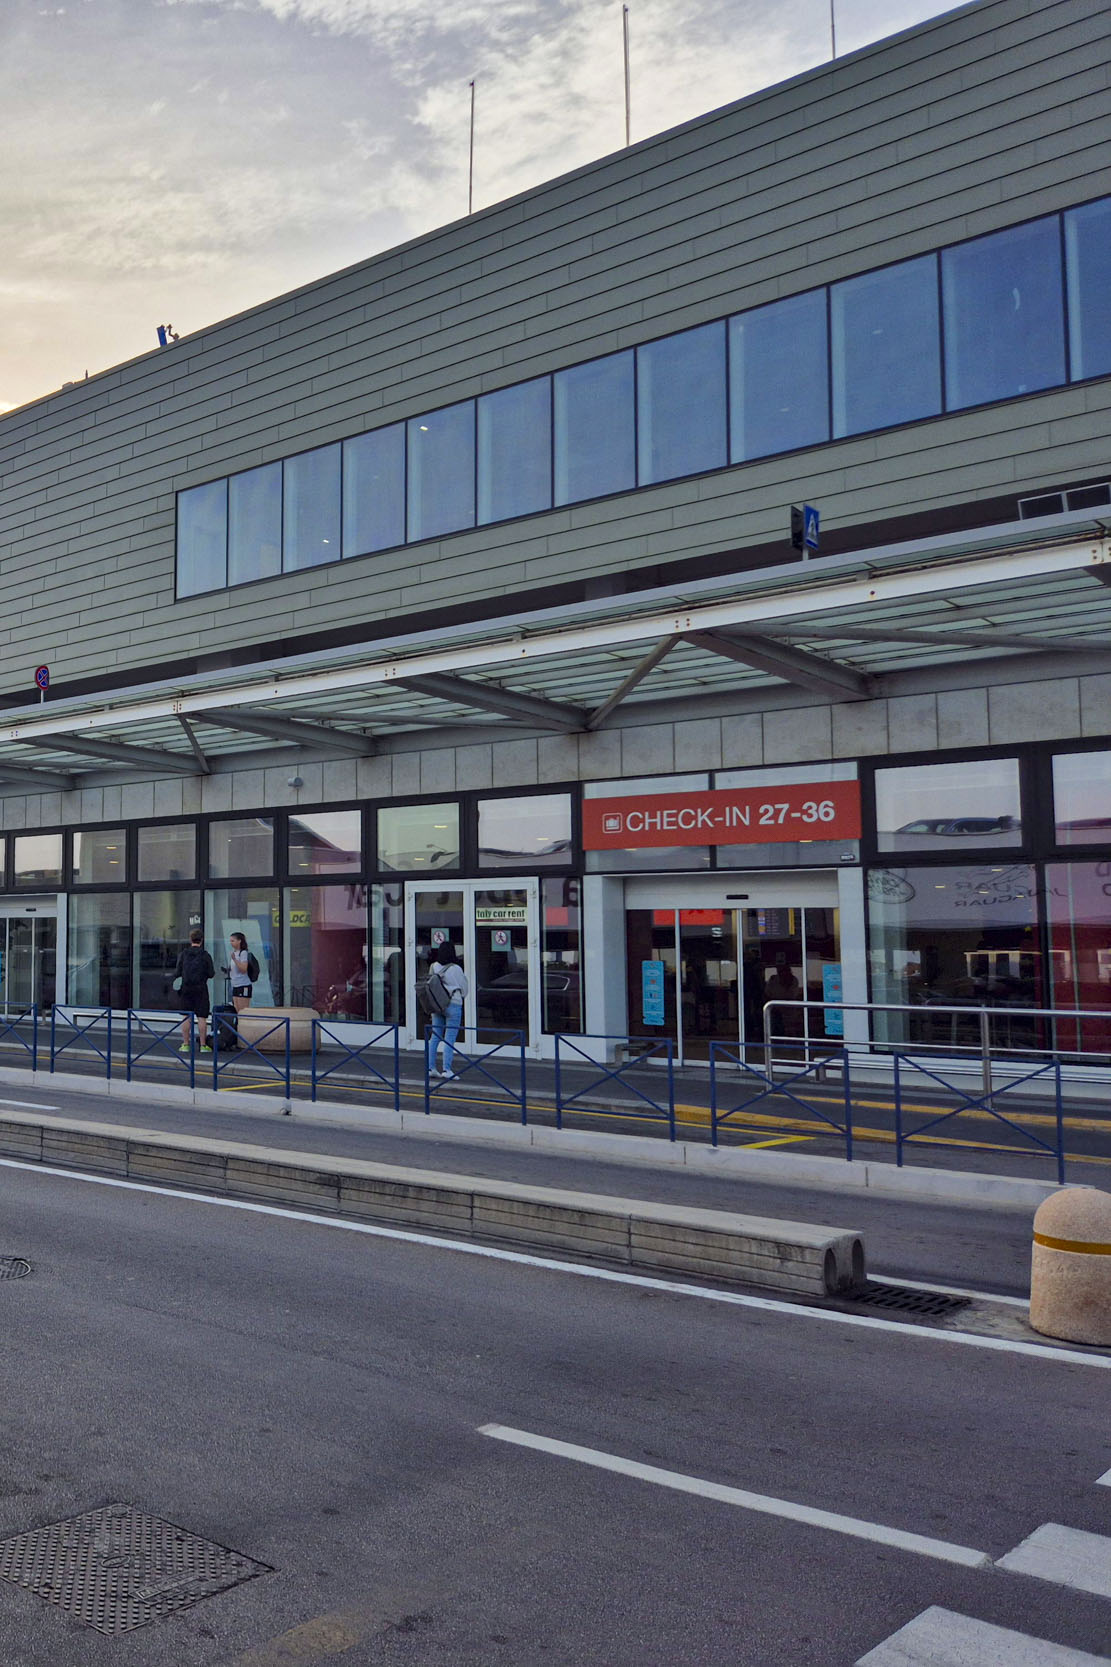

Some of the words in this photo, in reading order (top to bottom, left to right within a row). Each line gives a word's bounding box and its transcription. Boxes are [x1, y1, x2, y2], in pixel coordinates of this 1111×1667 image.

[626, 805, 750, 832] CHECK-IN
[758, 800, 835, 825] 27-36
[476, 909, 492, 919] taly
[493, 910, 506, 918] car
[507, 909, 525, 918] rent
